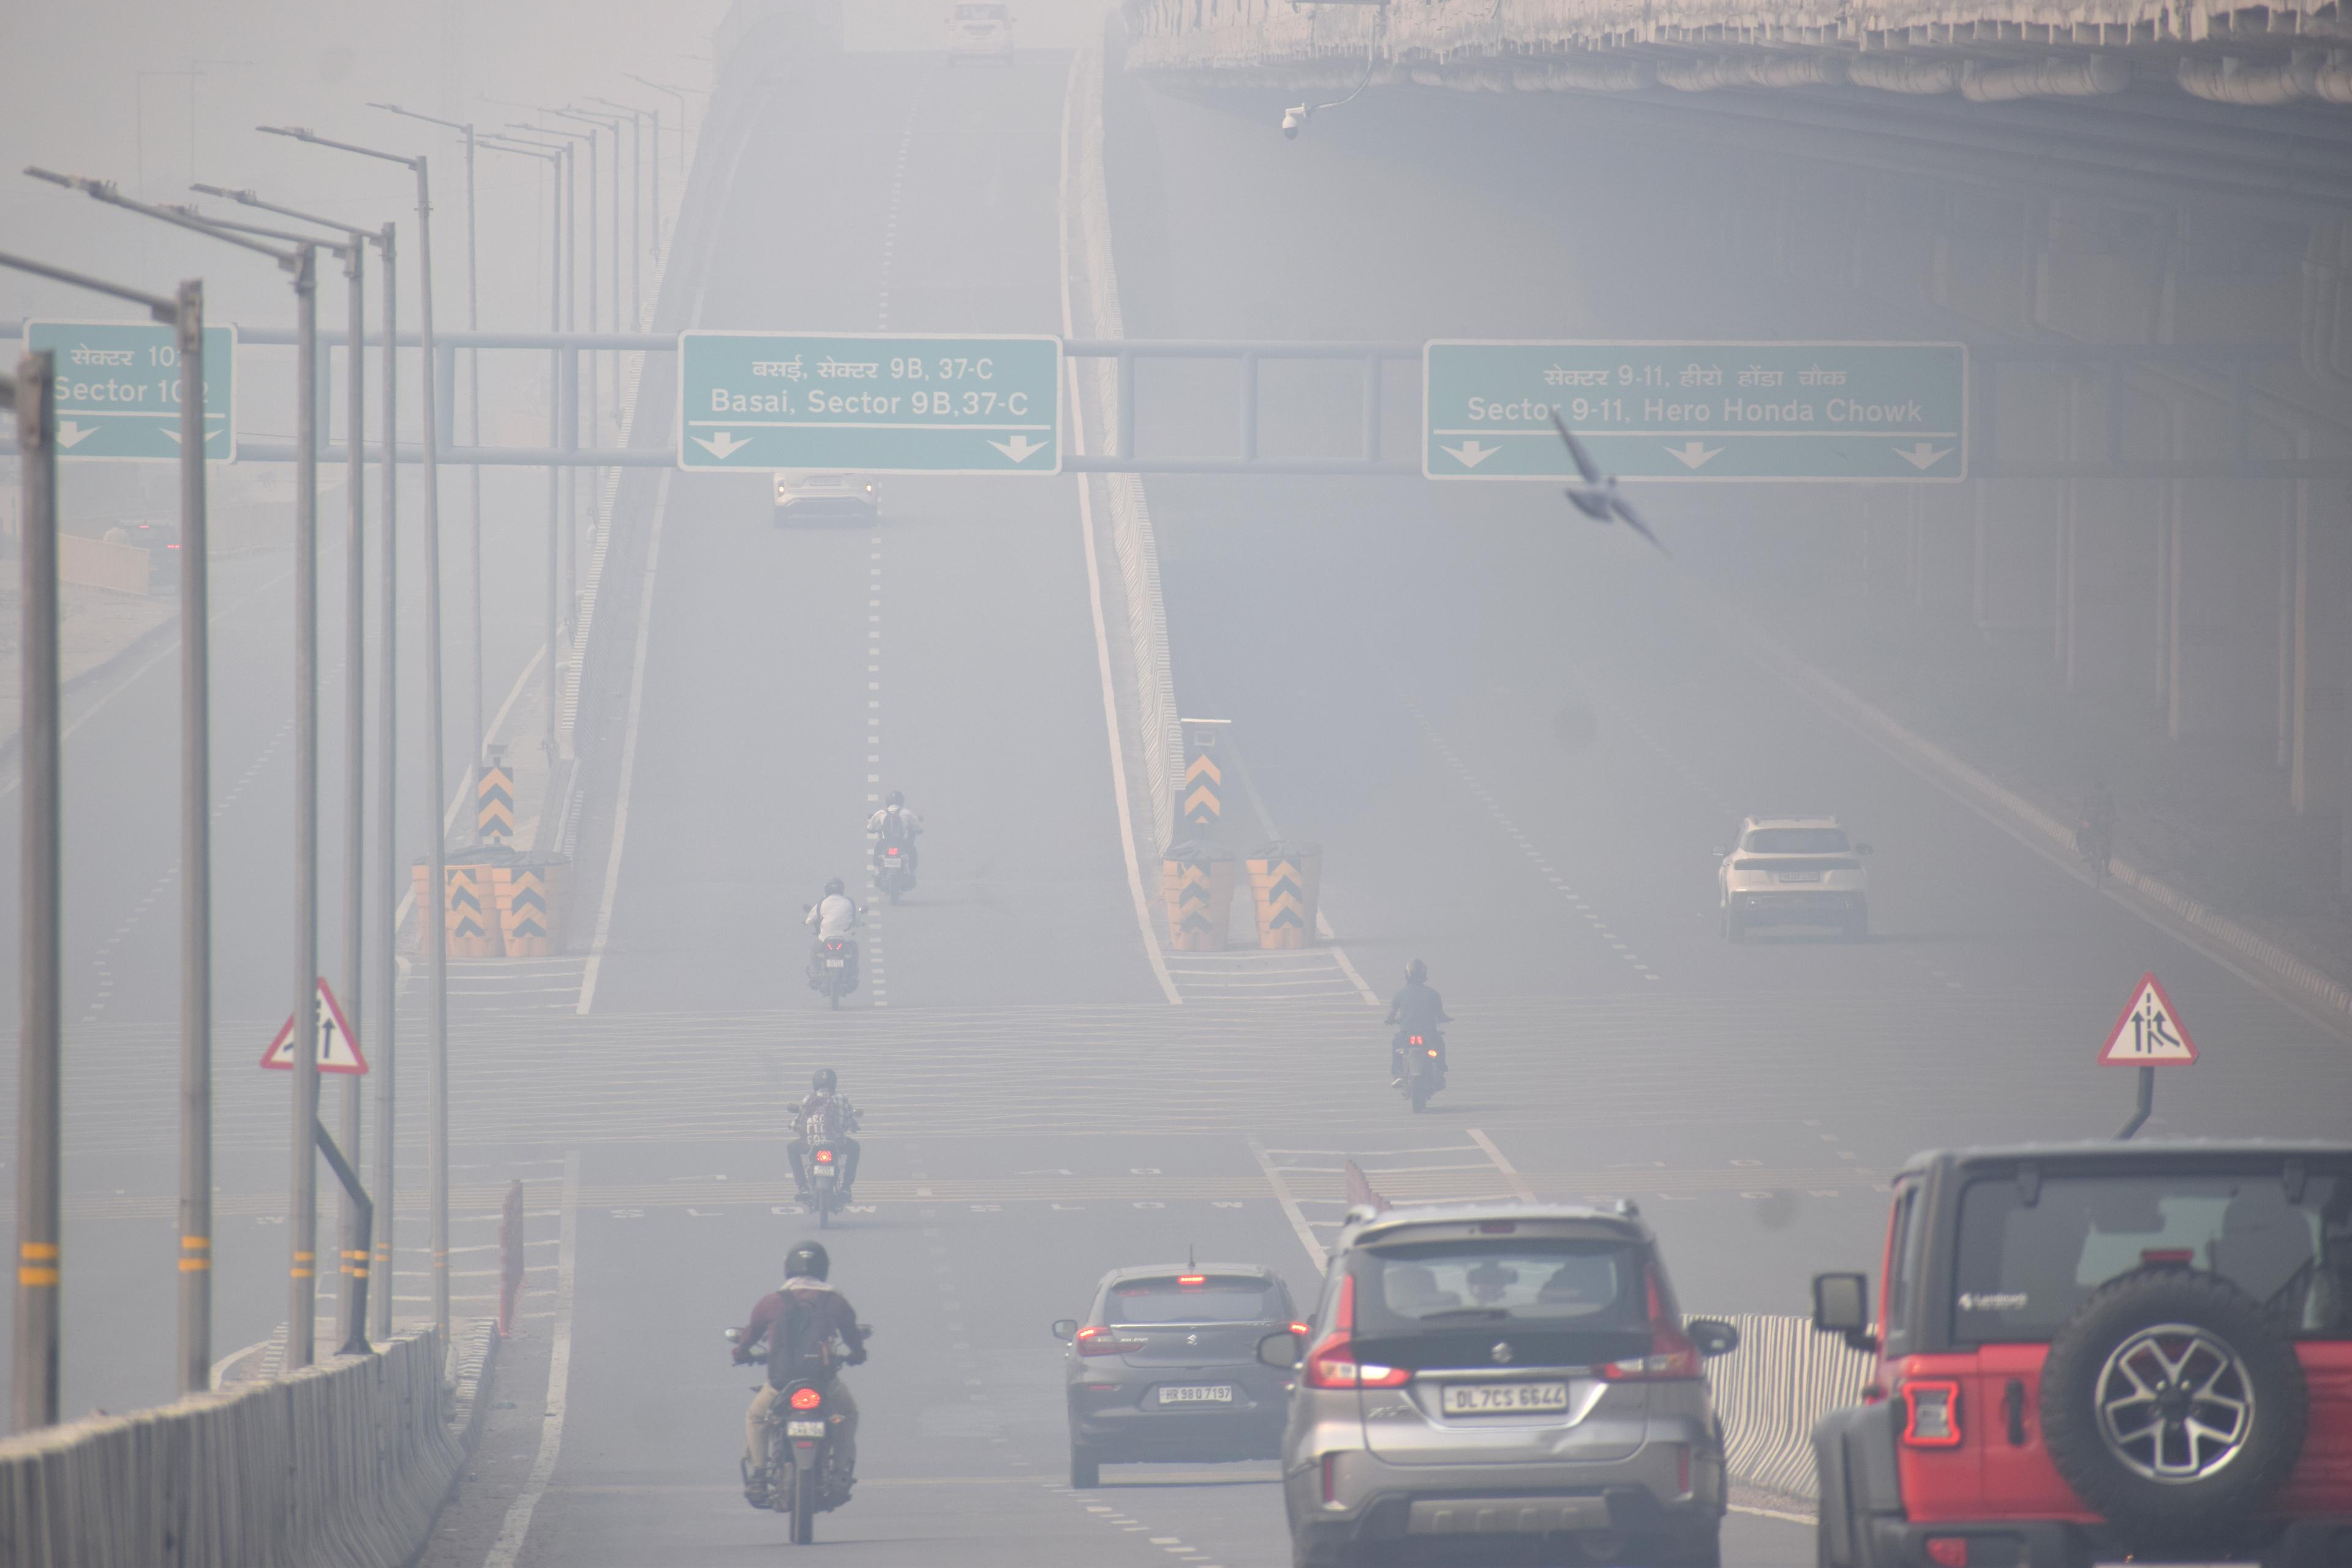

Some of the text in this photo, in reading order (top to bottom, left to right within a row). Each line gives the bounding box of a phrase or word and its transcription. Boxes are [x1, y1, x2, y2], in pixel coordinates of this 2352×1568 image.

[70, 343, 183, 367] सेक्टर 10
[752, 355, 993, 382] बसई, सेक्टर 9B, 37-C
[1543, 364, 1609, 386] सेक्टर
[1618, 365, 1670, 389] 9-11,
[1679, 364, 1722, 387] हीरो
[1798, 363, 1847, 387] चौक
[55, 376, 147, 402] Sector
[711, 388, 796, 415] Basai,
[808, 390, 901, 414] Sector
[1468, 397, 1923, 423] Sector 9-11, Hero Honda Chowk
[1166, 1389, 1178, 1400] HR
[1181, 1389, 1194, 1400] 98
[1205, 1387, 1231, 1399] 7197
[1519, 1387, 1562, 1406] 6644
